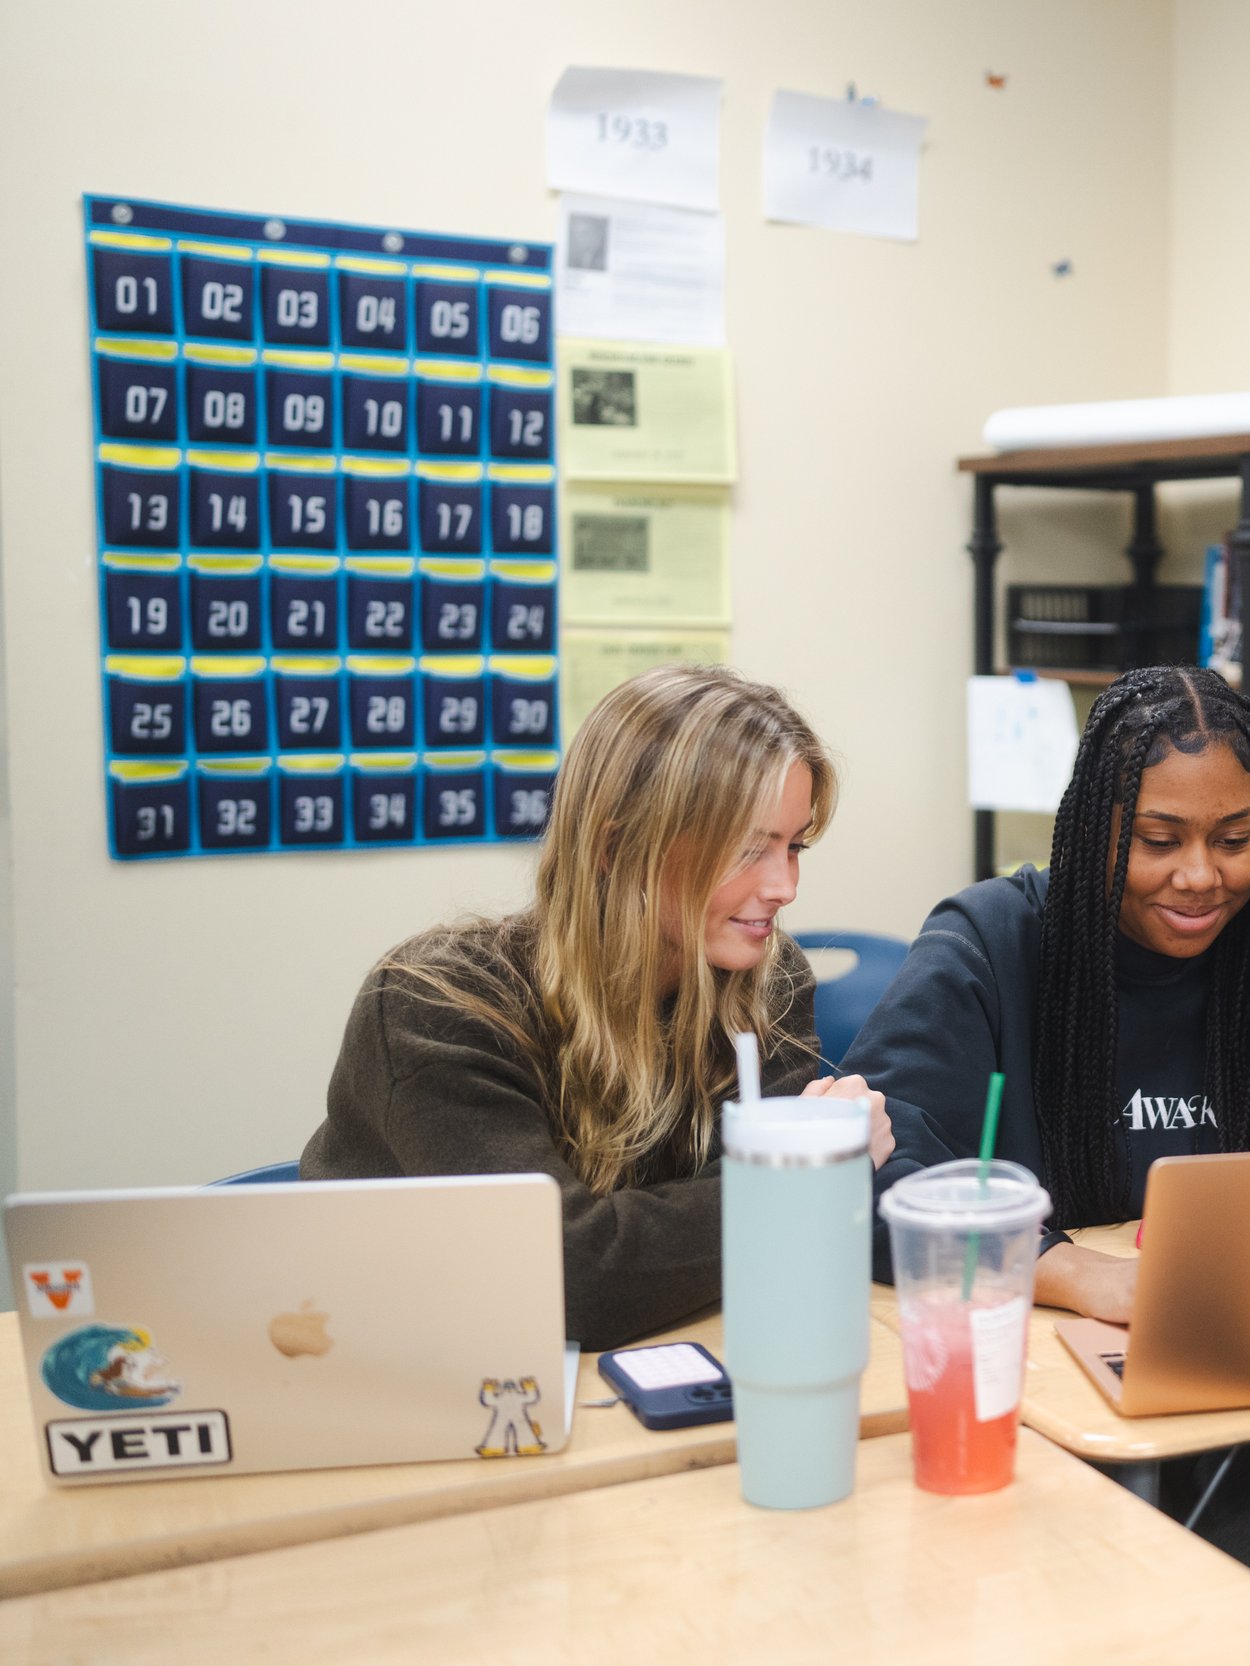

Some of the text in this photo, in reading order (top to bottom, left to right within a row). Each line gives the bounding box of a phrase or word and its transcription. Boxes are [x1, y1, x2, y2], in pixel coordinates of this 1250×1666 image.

[596, 111, 669, 152] 1933
[116, 276, 540, 344] 01 02 03 04 05 06
[126, 386, 543, 445] 07 08 09 10 11 12
[129, 493, 543, 540] 13 14 15 16 17 18
[129, 597, 544, 638] 19 20 21 22 23 24
[132, 697, 547, 737] 25 26 27 28 29 30
[137, 805, 173, 838] 31
[219, 800, 255, 833] 32
[296, 797, 333, 830] 33
[371, 795, 405, 827] 34
[441, 790, 475, 824] 35
[60, 1422, 213, 1463] YETI
